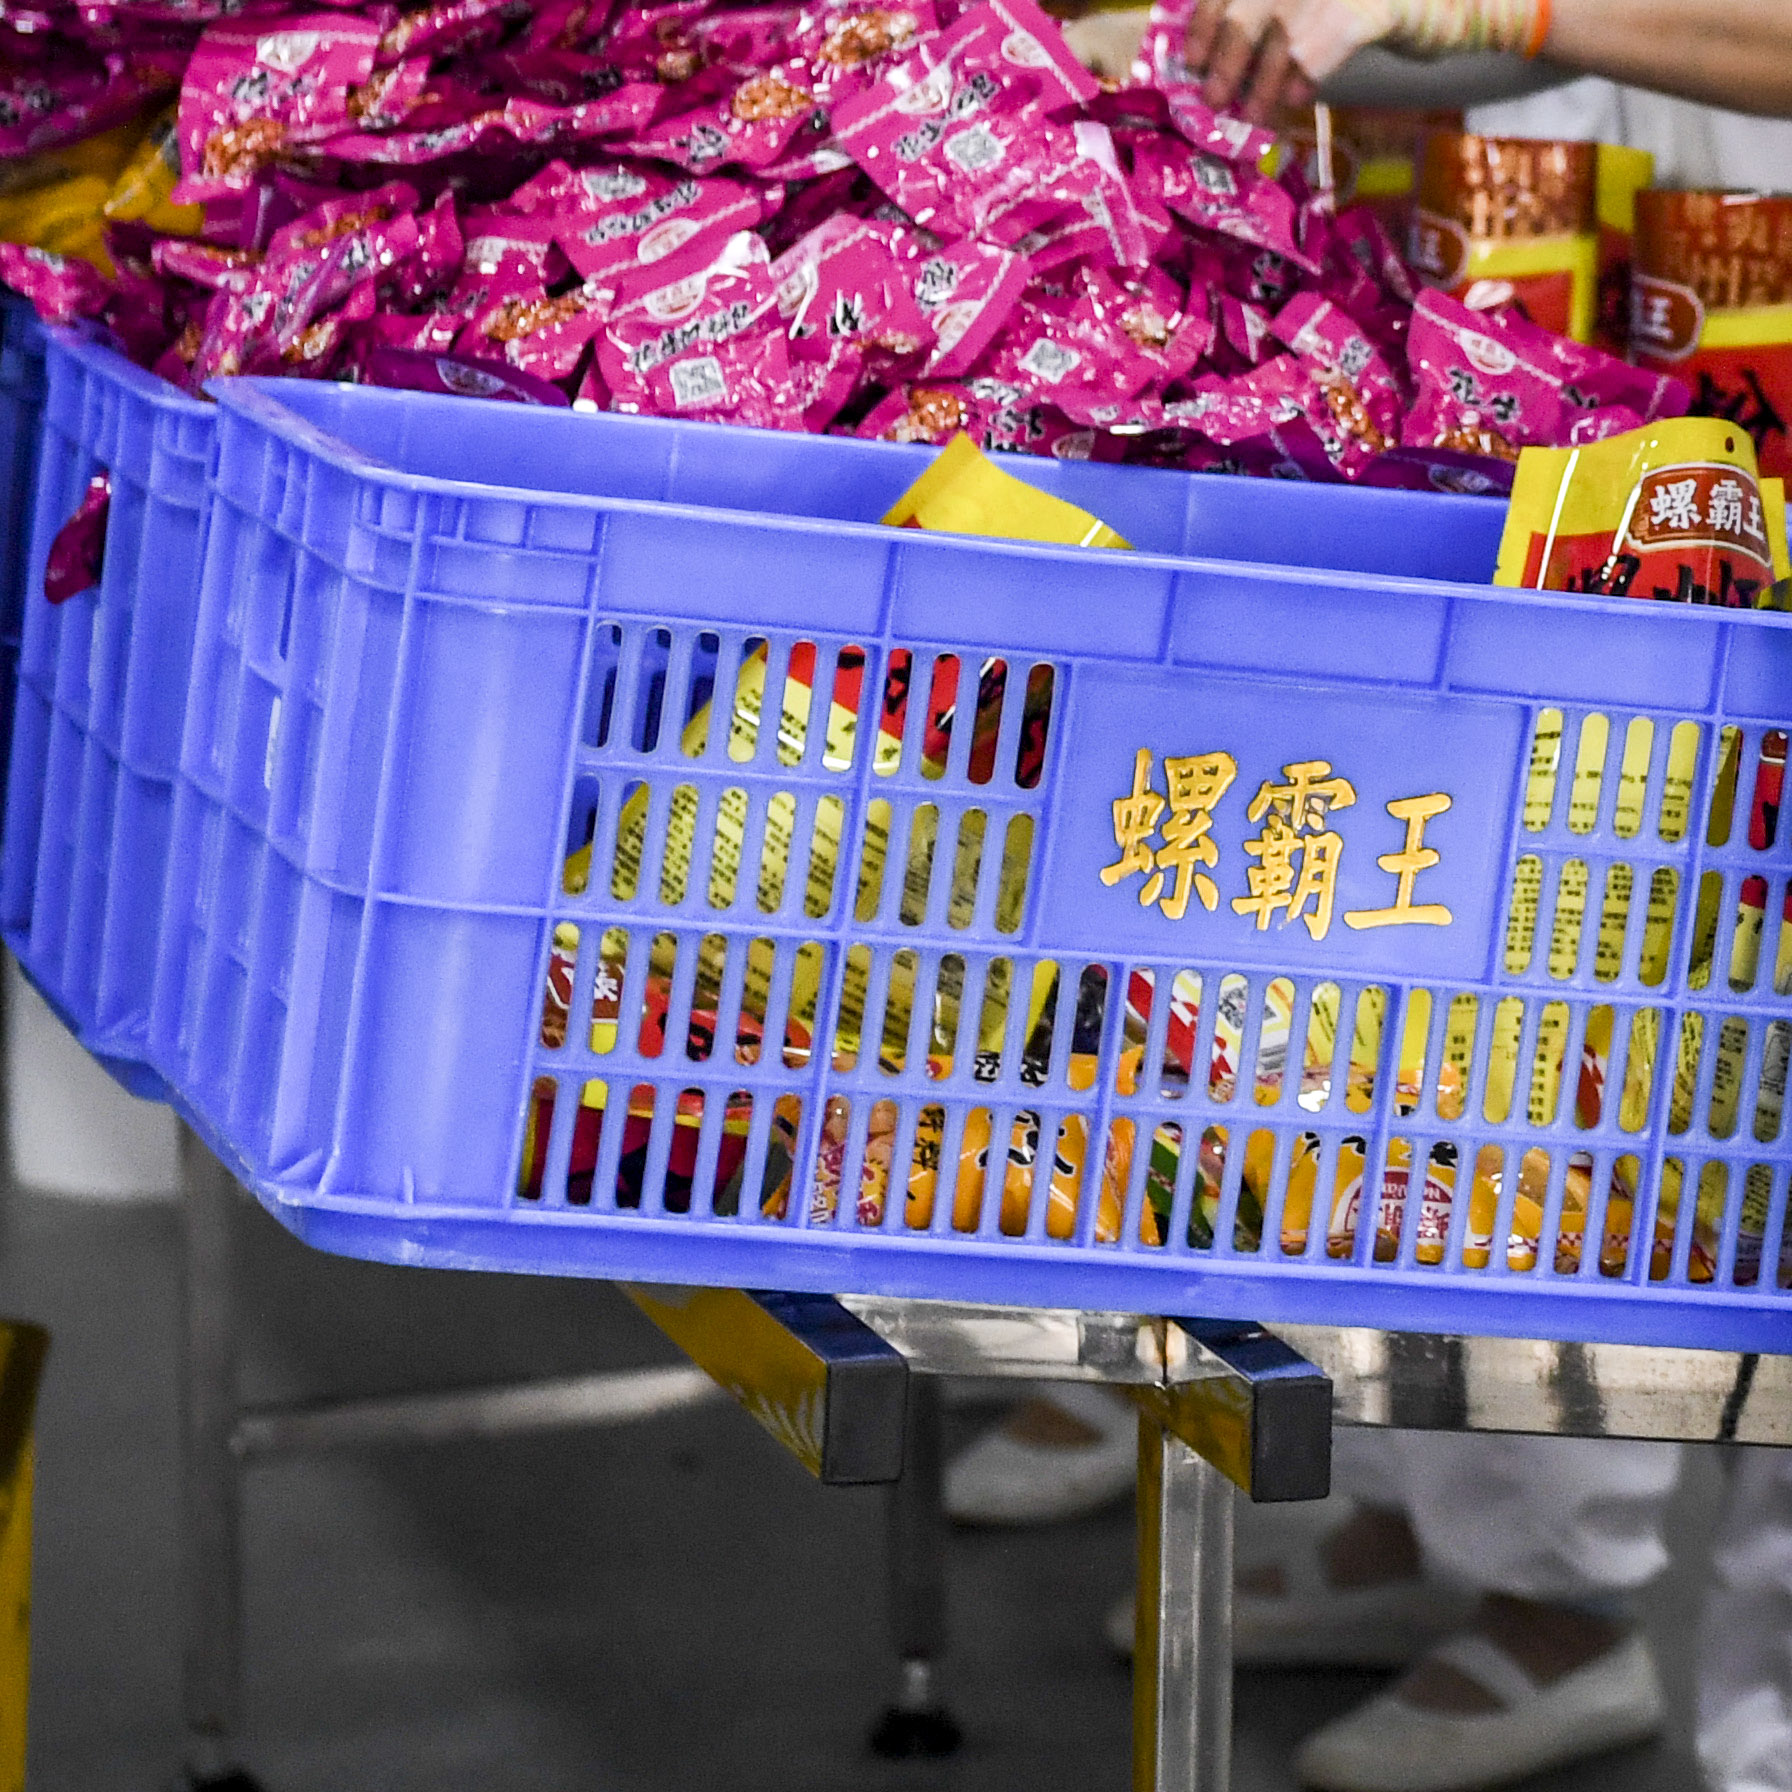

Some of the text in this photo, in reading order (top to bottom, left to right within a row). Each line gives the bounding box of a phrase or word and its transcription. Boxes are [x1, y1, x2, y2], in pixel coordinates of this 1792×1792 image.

[1650, 478, 1765, 542] 螺霸王
[1100, 748, 1453, 942] 螺霸王
